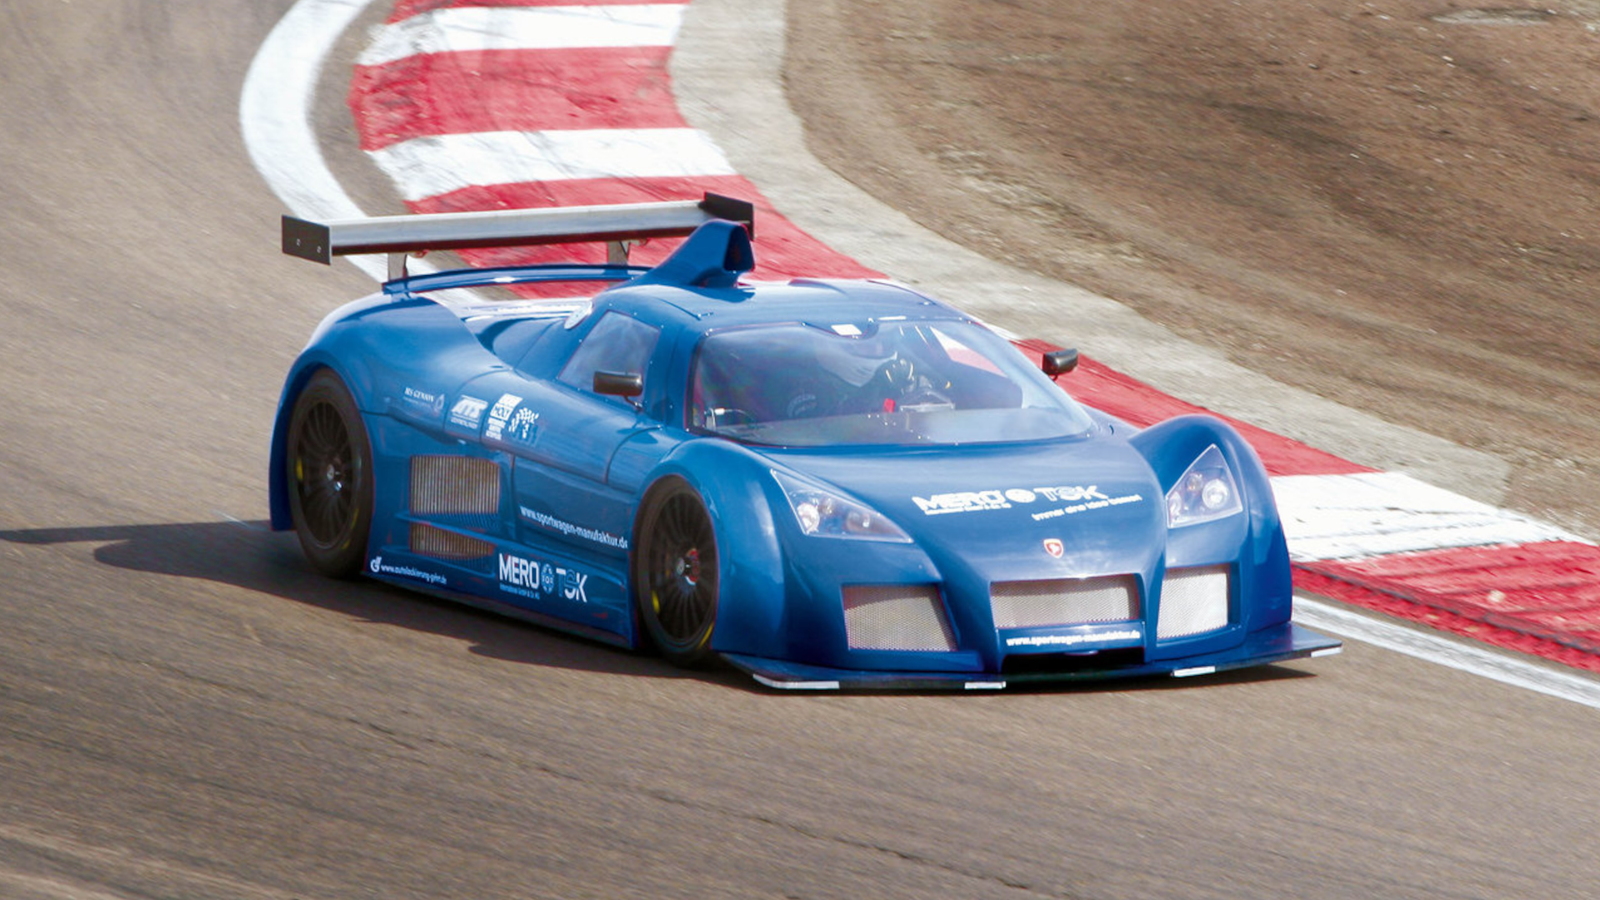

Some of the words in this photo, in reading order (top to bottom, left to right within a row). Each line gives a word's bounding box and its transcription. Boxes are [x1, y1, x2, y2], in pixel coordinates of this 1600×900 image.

[911, 490, 1006, 511] MERO
[520, 505, 628, 549] www.sportwagen-manufaktur.de
[499, 553, 540, 590] MERO
